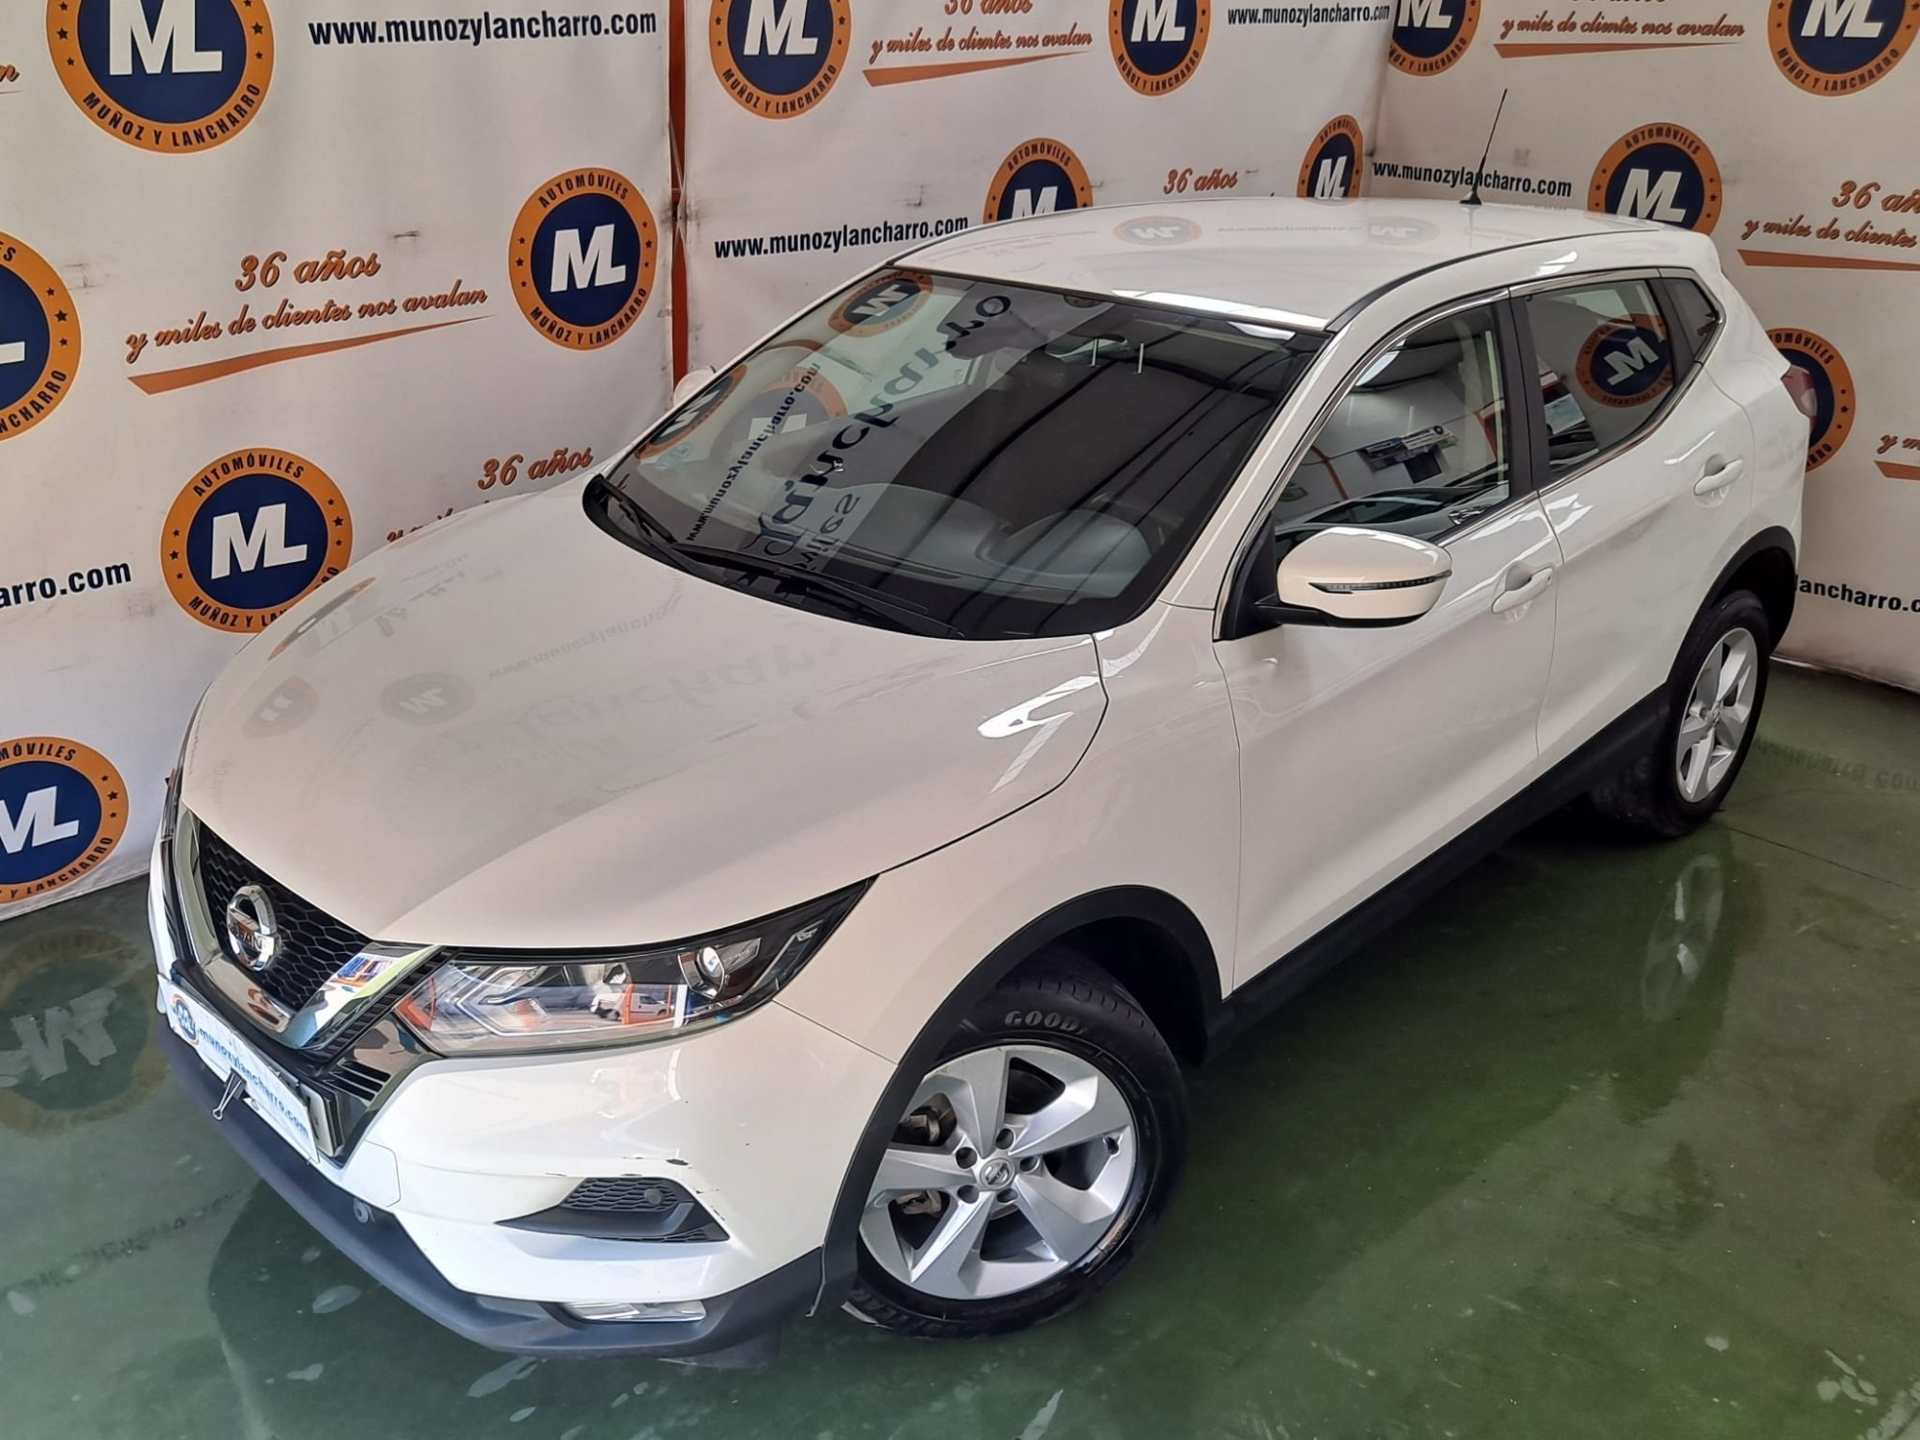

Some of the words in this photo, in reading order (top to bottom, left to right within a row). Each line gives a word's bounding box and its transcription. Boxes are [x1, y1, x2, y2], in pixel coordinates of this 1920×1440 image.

[308, 11, 656, 46] www.munozylancharro.com
[743, 0, 818, 55] ML
[1131, 0, 1186, 41] ML
[1227, 3, 1391, 28] www.munozylancharro.com
[1500, 20, 1514, 40] y
[1517, 10, 1553, 31] miles
[1557, 10, 1577, 32] de
[1580, 11, 1637, 34] clientes
[1642, 22, 1672, 34] nos
[1676, 14, 1744, 37] avalan
[1801, 0, 1884, 38] ML
[110, 0, 223, 75] ML
[869, 39, 883, 65] y
[886, 26, 932, 53] miles
[936, 26, 955, 51] de
[958, 26, 1012, 51] clientes
[1015, 34, 1039, 49] nos
[1041, 22, 1093, 48] avalan
[723, 68, 762, 108] MUÑOZ
[765, 101, 771, 112] Y
[776, 64, 837, 113] LANCHARRO
[1824, 48, 1899, 91] LANCHARRO
[83, 92, 146, 141] MUÑOZ
[154, 130, 162, 145] Y
[172, 83, 261, 147] LANCHARRO
[1007, 142, 1070, 171] AUTOMÓVILES
[1625, 127, 1700, 155] AUTOMÓVILES
[538, 171, 628, 209] AUTOMÓVILES
[1163, 168, 1192, 195] 36
[1194, 168, 1238, 192] años
[1372, 162, 1572, 197] ww.munozylancharro.com
[1616, 168, 1687, 222] ML
[1831, 180, 1881, 209] 36
[714, 216, 968, 260] www.munozylancharro.com
[1741, 220, 1759, 240] y
[1763, 214, 1812, 238] miles
[1816, 217, 1840, 240] de
[1844, 220, 1918, 248] clientes
[235, 251, 287, 292] 36
[293, 249, 381, 284] años
[551, 223, 626, 293] ML
[125, 333, 148, 364] y
[154, 311, 223, 347] miles
[228, 304, 257, 335] de
[261, 298, 353, 329] clientes
[358, 298, 398, 319] nos
[402, 279, 488, 312] avalan
[530, 306, 572, 342] MUÑOZ
[577, 332, 584, 345] Y
[589, 288, 647, 344] LANCHARRO
[1877, 434, 1898, 455] y
[192, 452, 305, 497] AUTOMÓVILES
[477, 454, 524, 490] 36
[527, 447, 594, 480] años
[211, 503, 307, 579] ML
[188, 596, 239, 628] MUÑOZ
[246, 615, 253, 628] Y
[27, 837, 113, 895] LANCHARRO
[1004, 1010, 1087, 1035] GOOD
